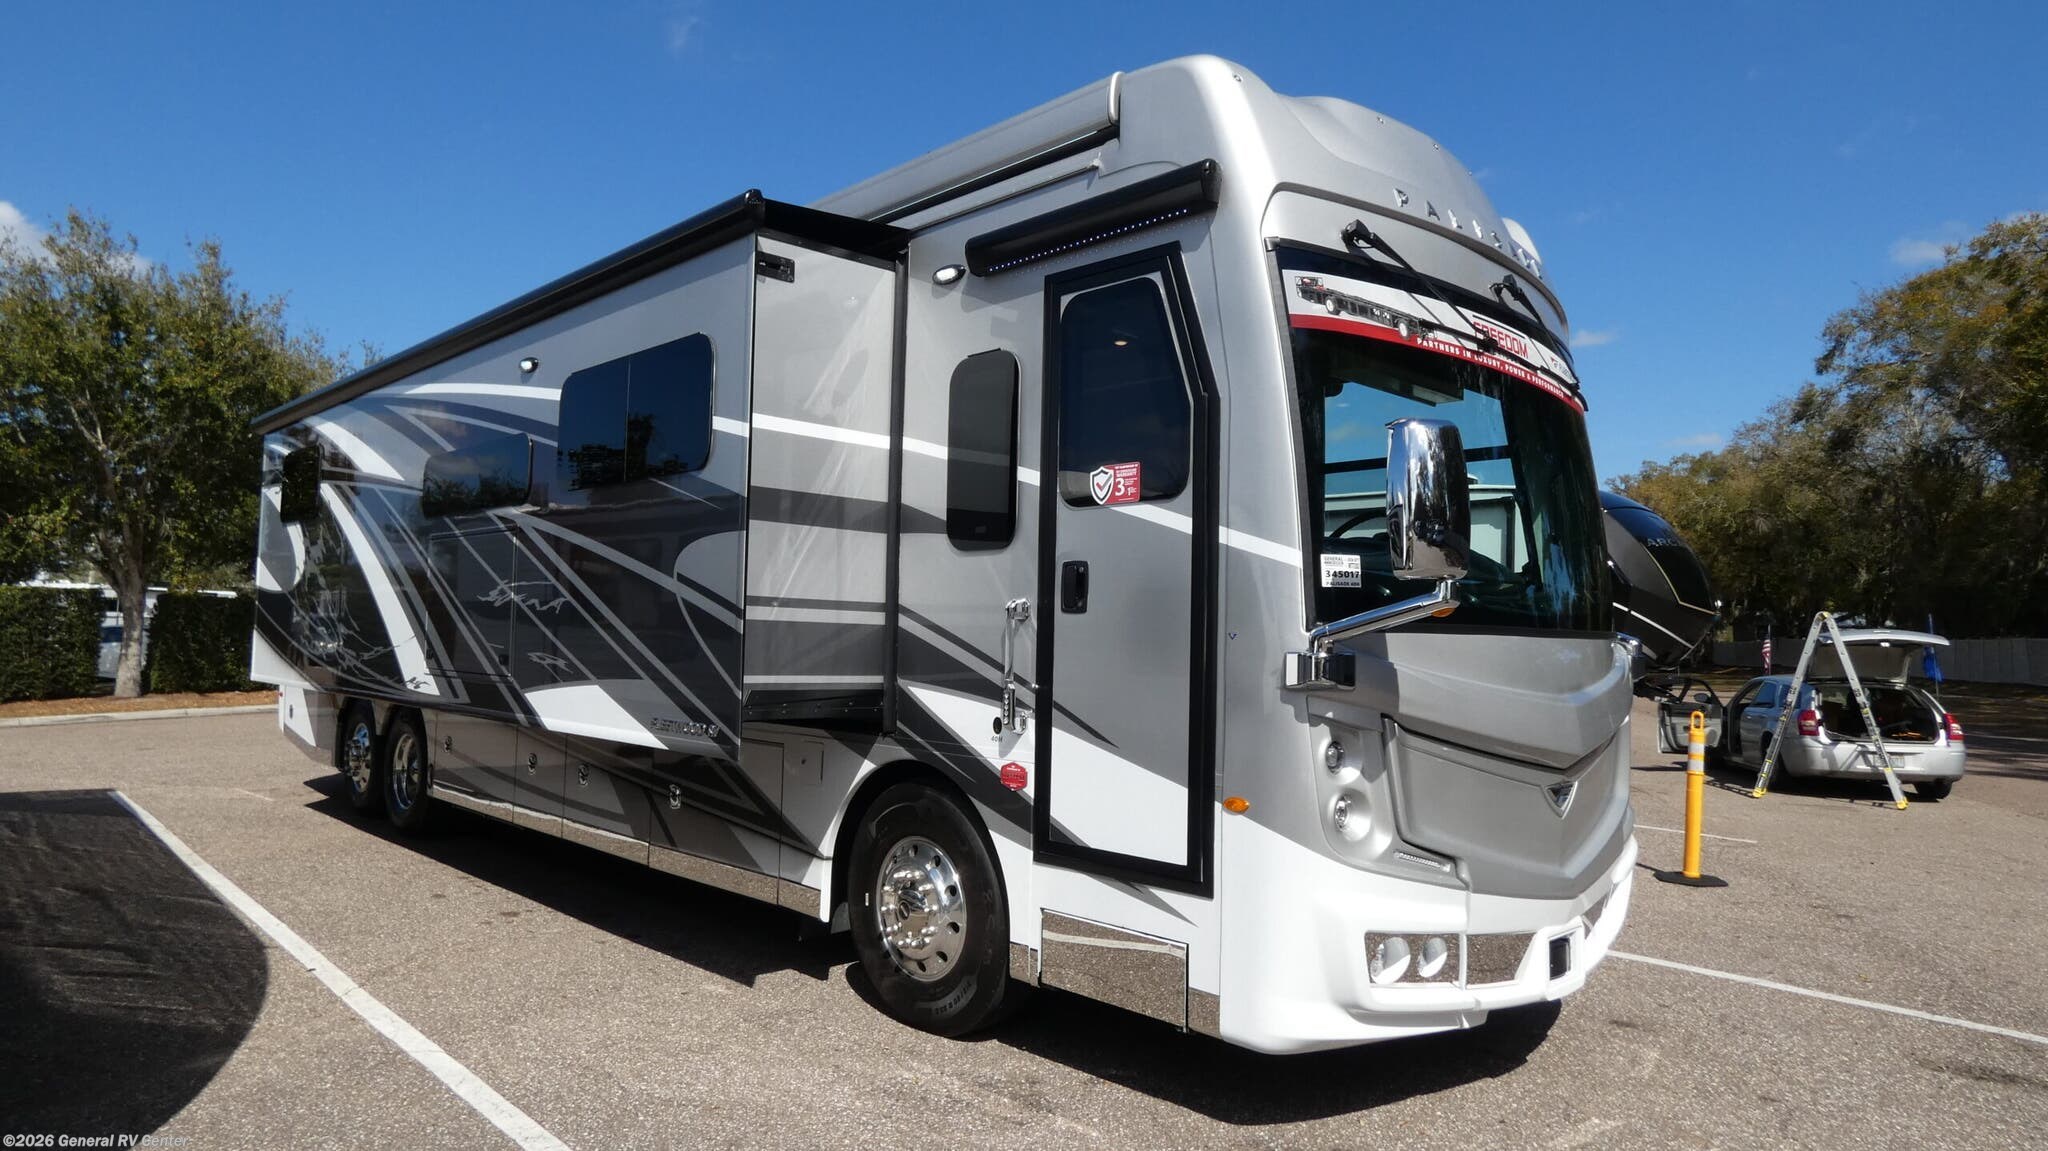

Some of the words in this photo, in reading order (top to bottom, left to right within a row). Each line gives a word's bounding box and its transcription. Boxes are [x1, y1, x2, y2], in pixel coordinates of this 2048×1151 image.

[1473, 321, 1530, 359] FREEDOM
[1416, 336, 1460, 356] PARTNERS
[1463, 350, 1472, 359] IN
[1505, 363, 1526, 378] POWER
[1532, 375, 1565, 399] PERFORMANCE
[1115, 477, 1125, 496] 3
